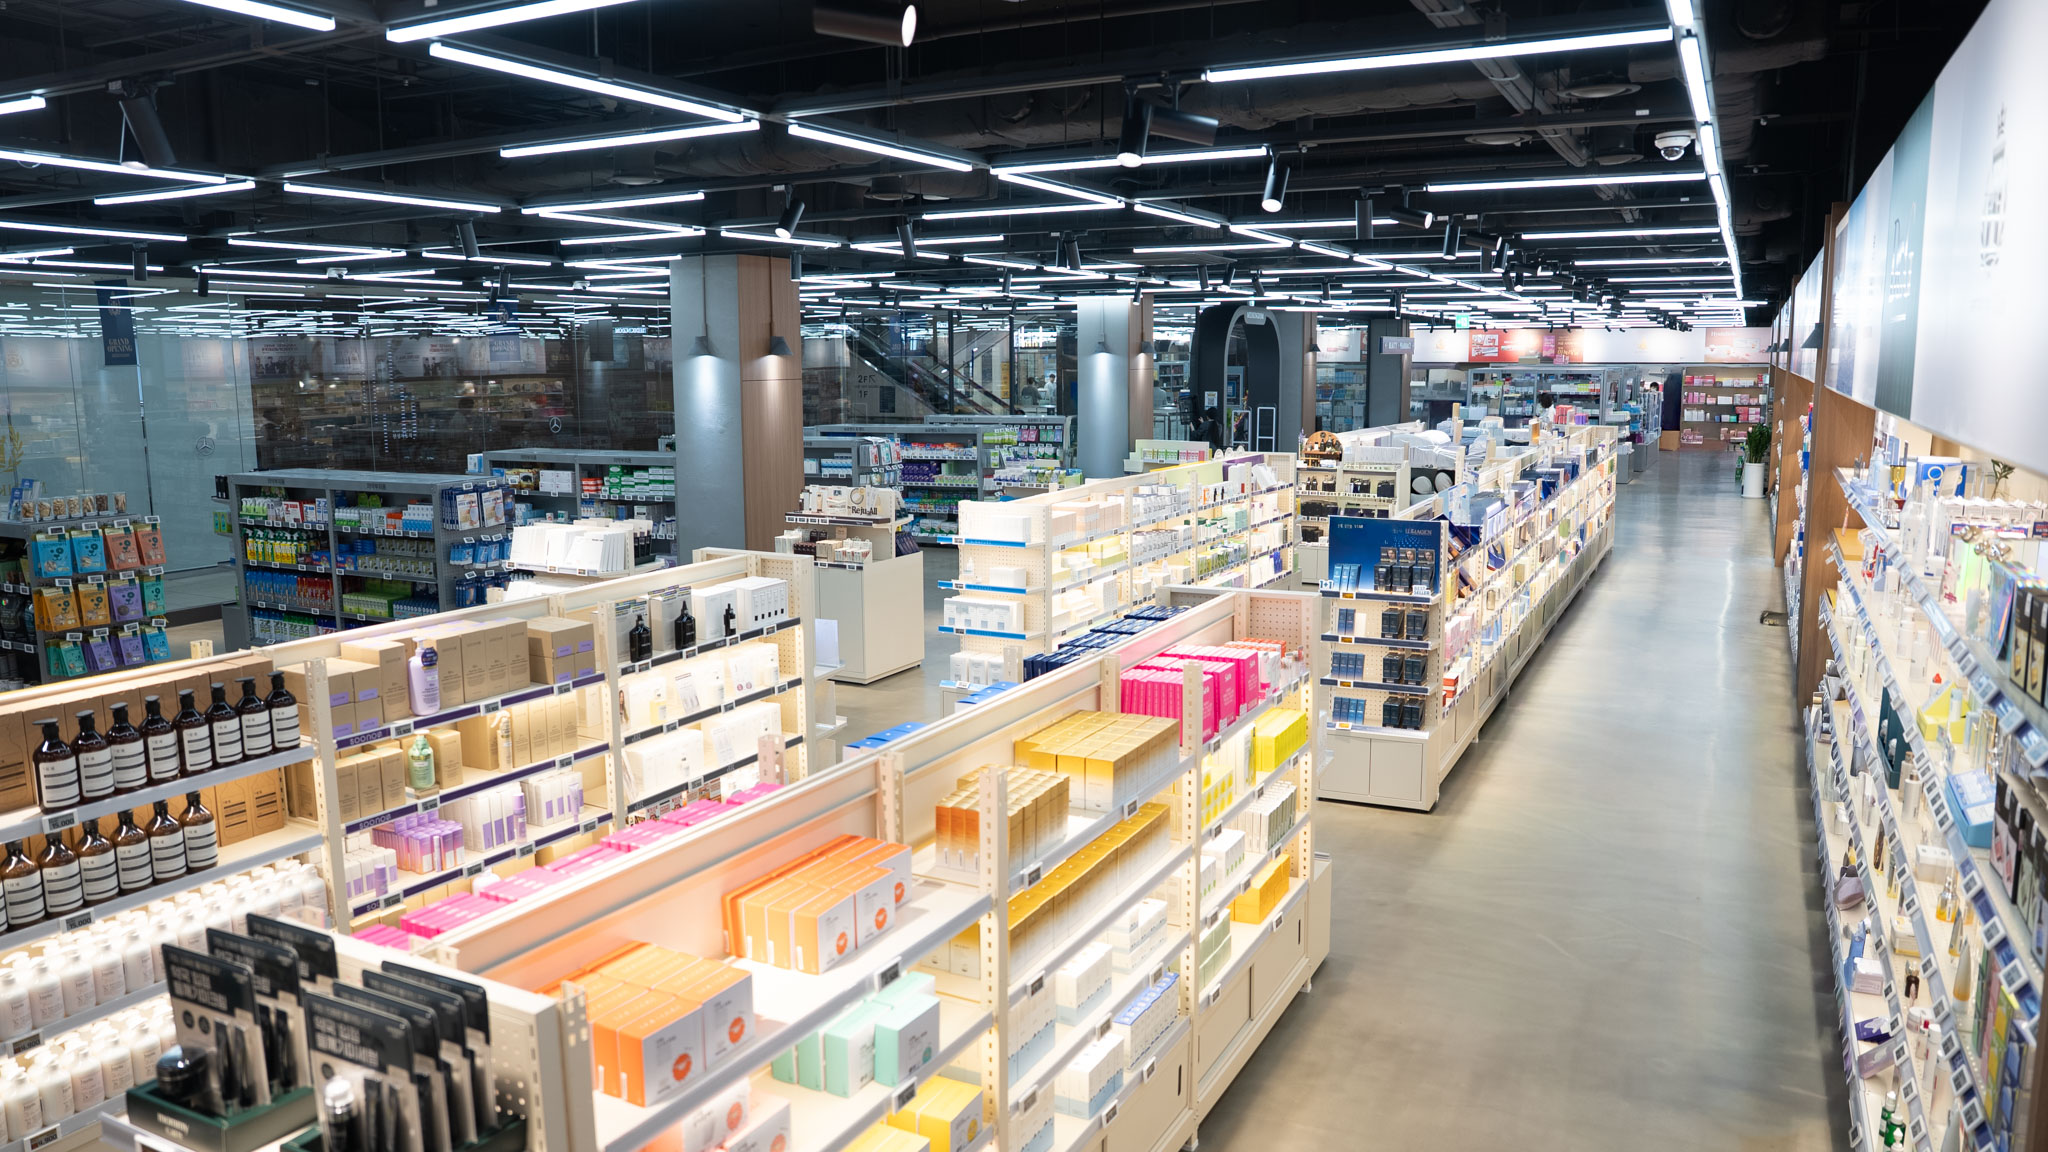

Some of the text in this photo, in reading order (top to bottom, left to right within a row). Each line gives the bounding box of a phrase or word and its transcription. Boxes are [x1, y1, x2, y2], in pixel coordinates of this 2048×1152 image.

[108, 338, 130, 346] GRAND
[107, 345, 133, 353] OPENING
[857, 374, 868, 383] 2F
[859, 390, 868, 398] 1F
